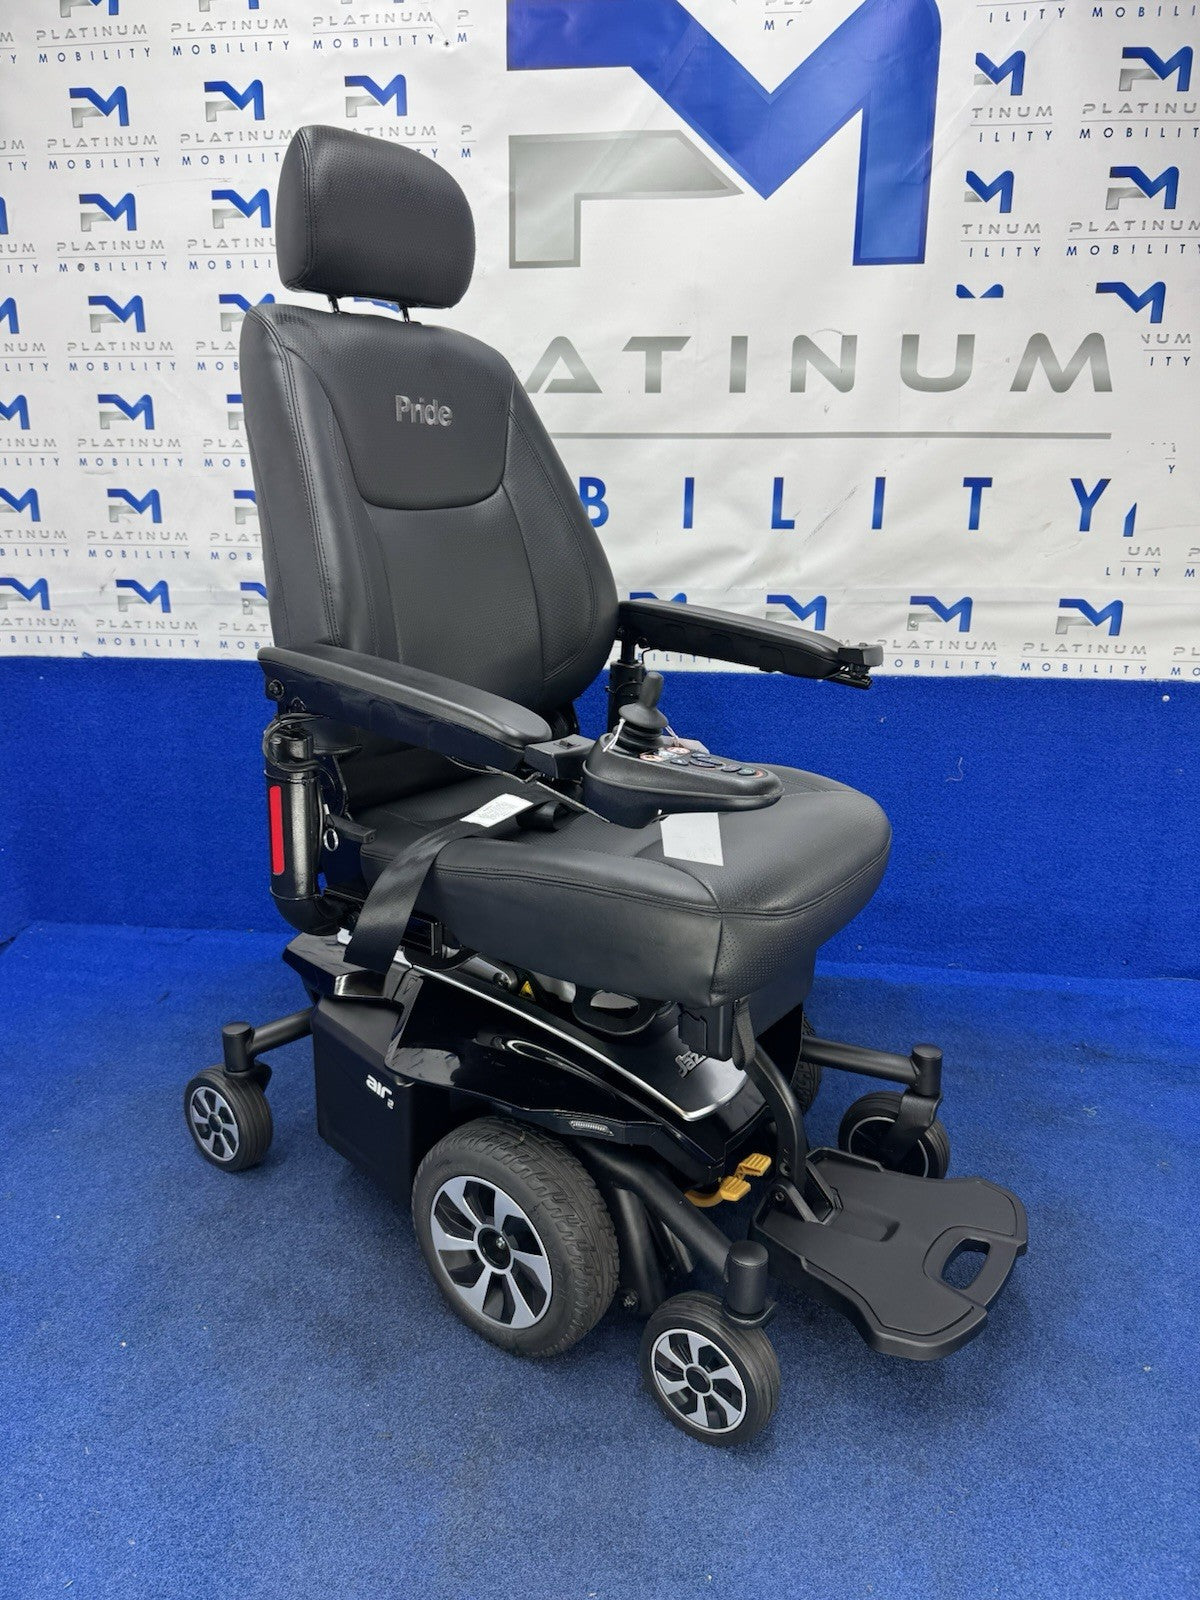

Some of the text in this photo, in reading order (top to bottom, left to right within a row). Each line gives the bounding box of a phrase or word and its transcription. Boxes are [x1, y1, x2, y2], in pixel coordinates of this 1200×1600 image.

[1092, 5, 1196, 17] MOBILI
[171, 18, 289, 33] PLATINUM
[313, 12, 433, 27] PLATINUM
[37, 24, 147, 40] PLATINUM
[313, 34, 434, 50] MOBILITY
[172, 41, 289, 56] MOBILITY
[38, 47, 150, 64] MOBILITY
[1082, 102, 1198, 114] PLATINU
[180, 129, 293, 144] PLATINUM
[1080, 127, 1200, 139] MOBILIT
[47, 134, 158, 148] PLATINUM
[49, 157, 160, 170] MOBILITY
[182, 152, 280, 166] MOBILIT
[57, 239, 165, 252] PLATINUM
[187, 237, 276, 249] PLATINU
[1066, 244, 1200, 256] MOBILIT
[59, 261, 168, 272] MOBILITY
[189, 259, 271, 270] MOBILI
[67, 341, 174, 352] PLATINUM
[5, 363, 49, 372] LITY
[69, 361, 176, 371] MOBILITY
[523, 332, 1113, 394] ATINUM
[395, 394, 453, 427] Pride
[77, 438, 181, 448] PLATINUM
[4, 458, 60, 466] ILITY
[79, 458, 183, 467] MOBILITY
[578, 476, 1111, 532] BILITY
[0, 530, 67, 539] TINUM
[87, 530, 188, 540] PLATINUM
[209, 532, 261, 542] PLAT
[88, 549, 191, 559] MOBILITY
[0, 617, 77, 627] ATINUM
[96, 619, 198, 630] PLATINUM
[218, 622, 268, 631] PLAT
[11, 635, 78, 644] BILITY
[98, 637, 200, 647] MOBILITY
[1023, 642, 1147, 655] PLATINUM
[894, 658, 997, 670] OBILITY
[1020, 662, 1147, 674] MOBILITY
[366, 1074, 393, 1099] air
